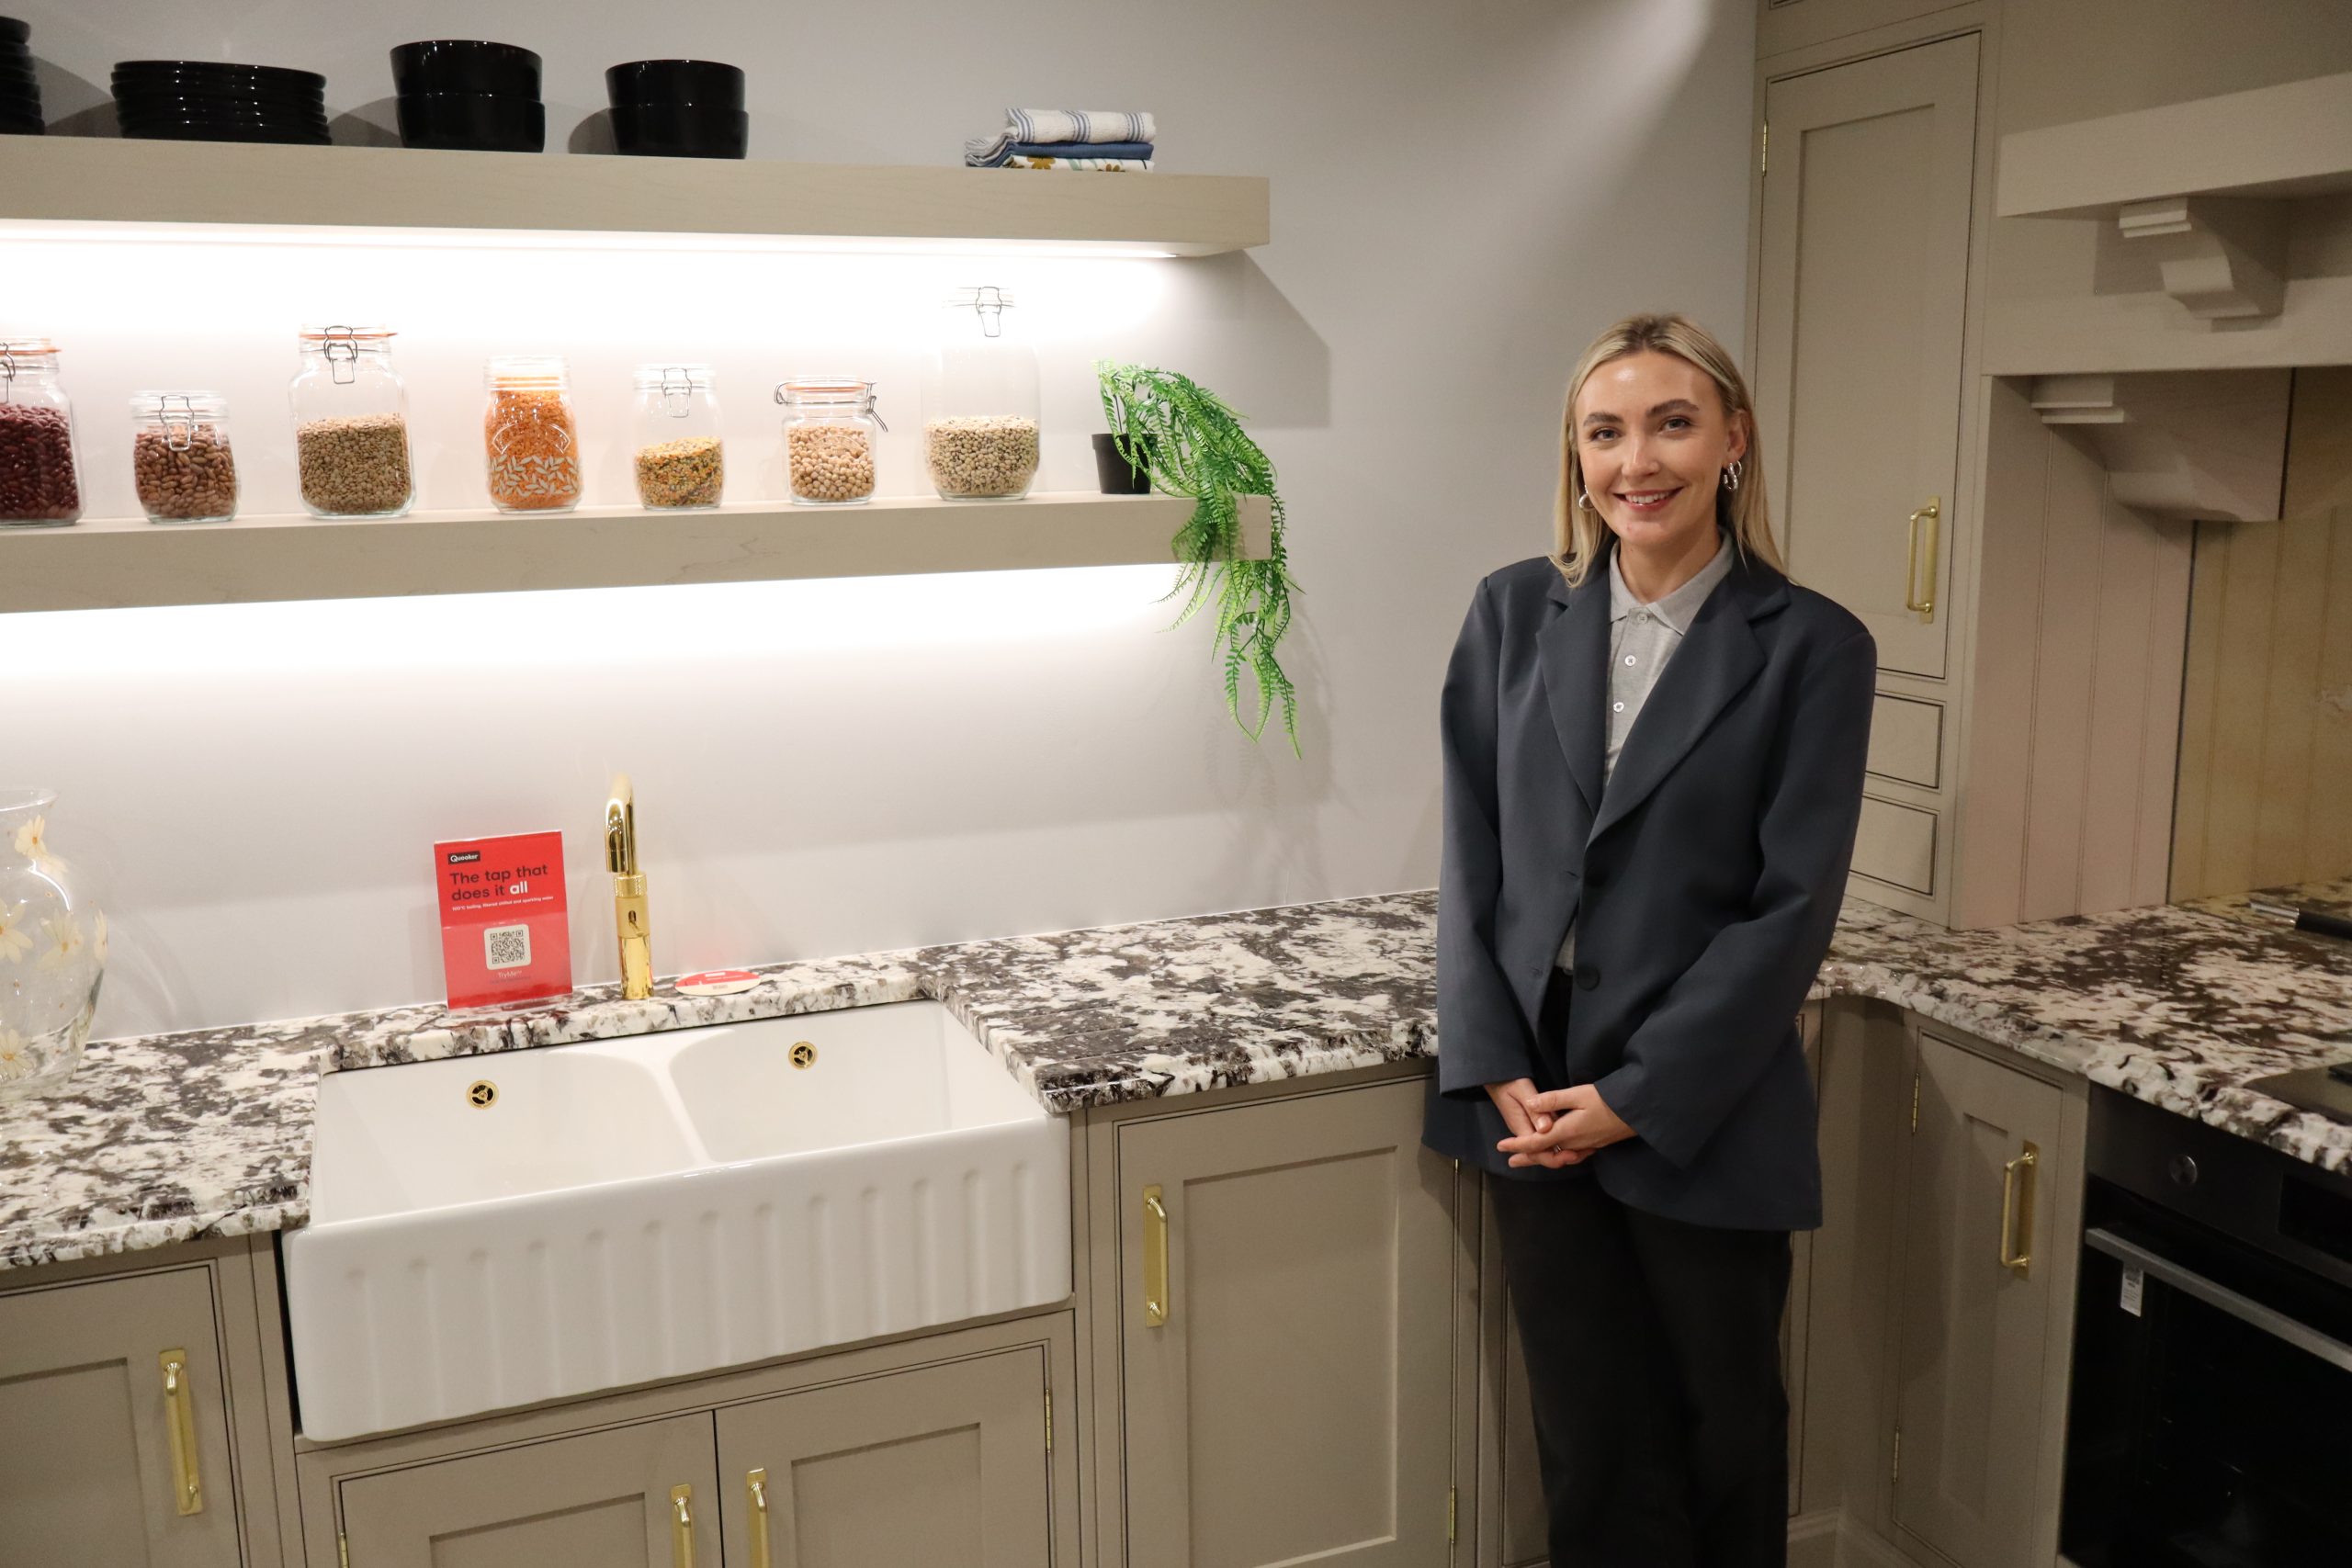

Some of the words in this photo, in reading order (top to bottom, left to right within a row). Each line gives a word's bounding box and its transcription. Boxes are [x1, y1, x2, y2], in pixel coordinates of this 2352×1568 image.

[450, 853, 479, 863] Quooker
[449, 872, 480, 885] The
[485, 870, 511, 883] tap
[516, 864, 548, 878] that
[451, 888, 491, 901] does
[494, 885, 505, 897] it
[509, 880, 528, 895] all
